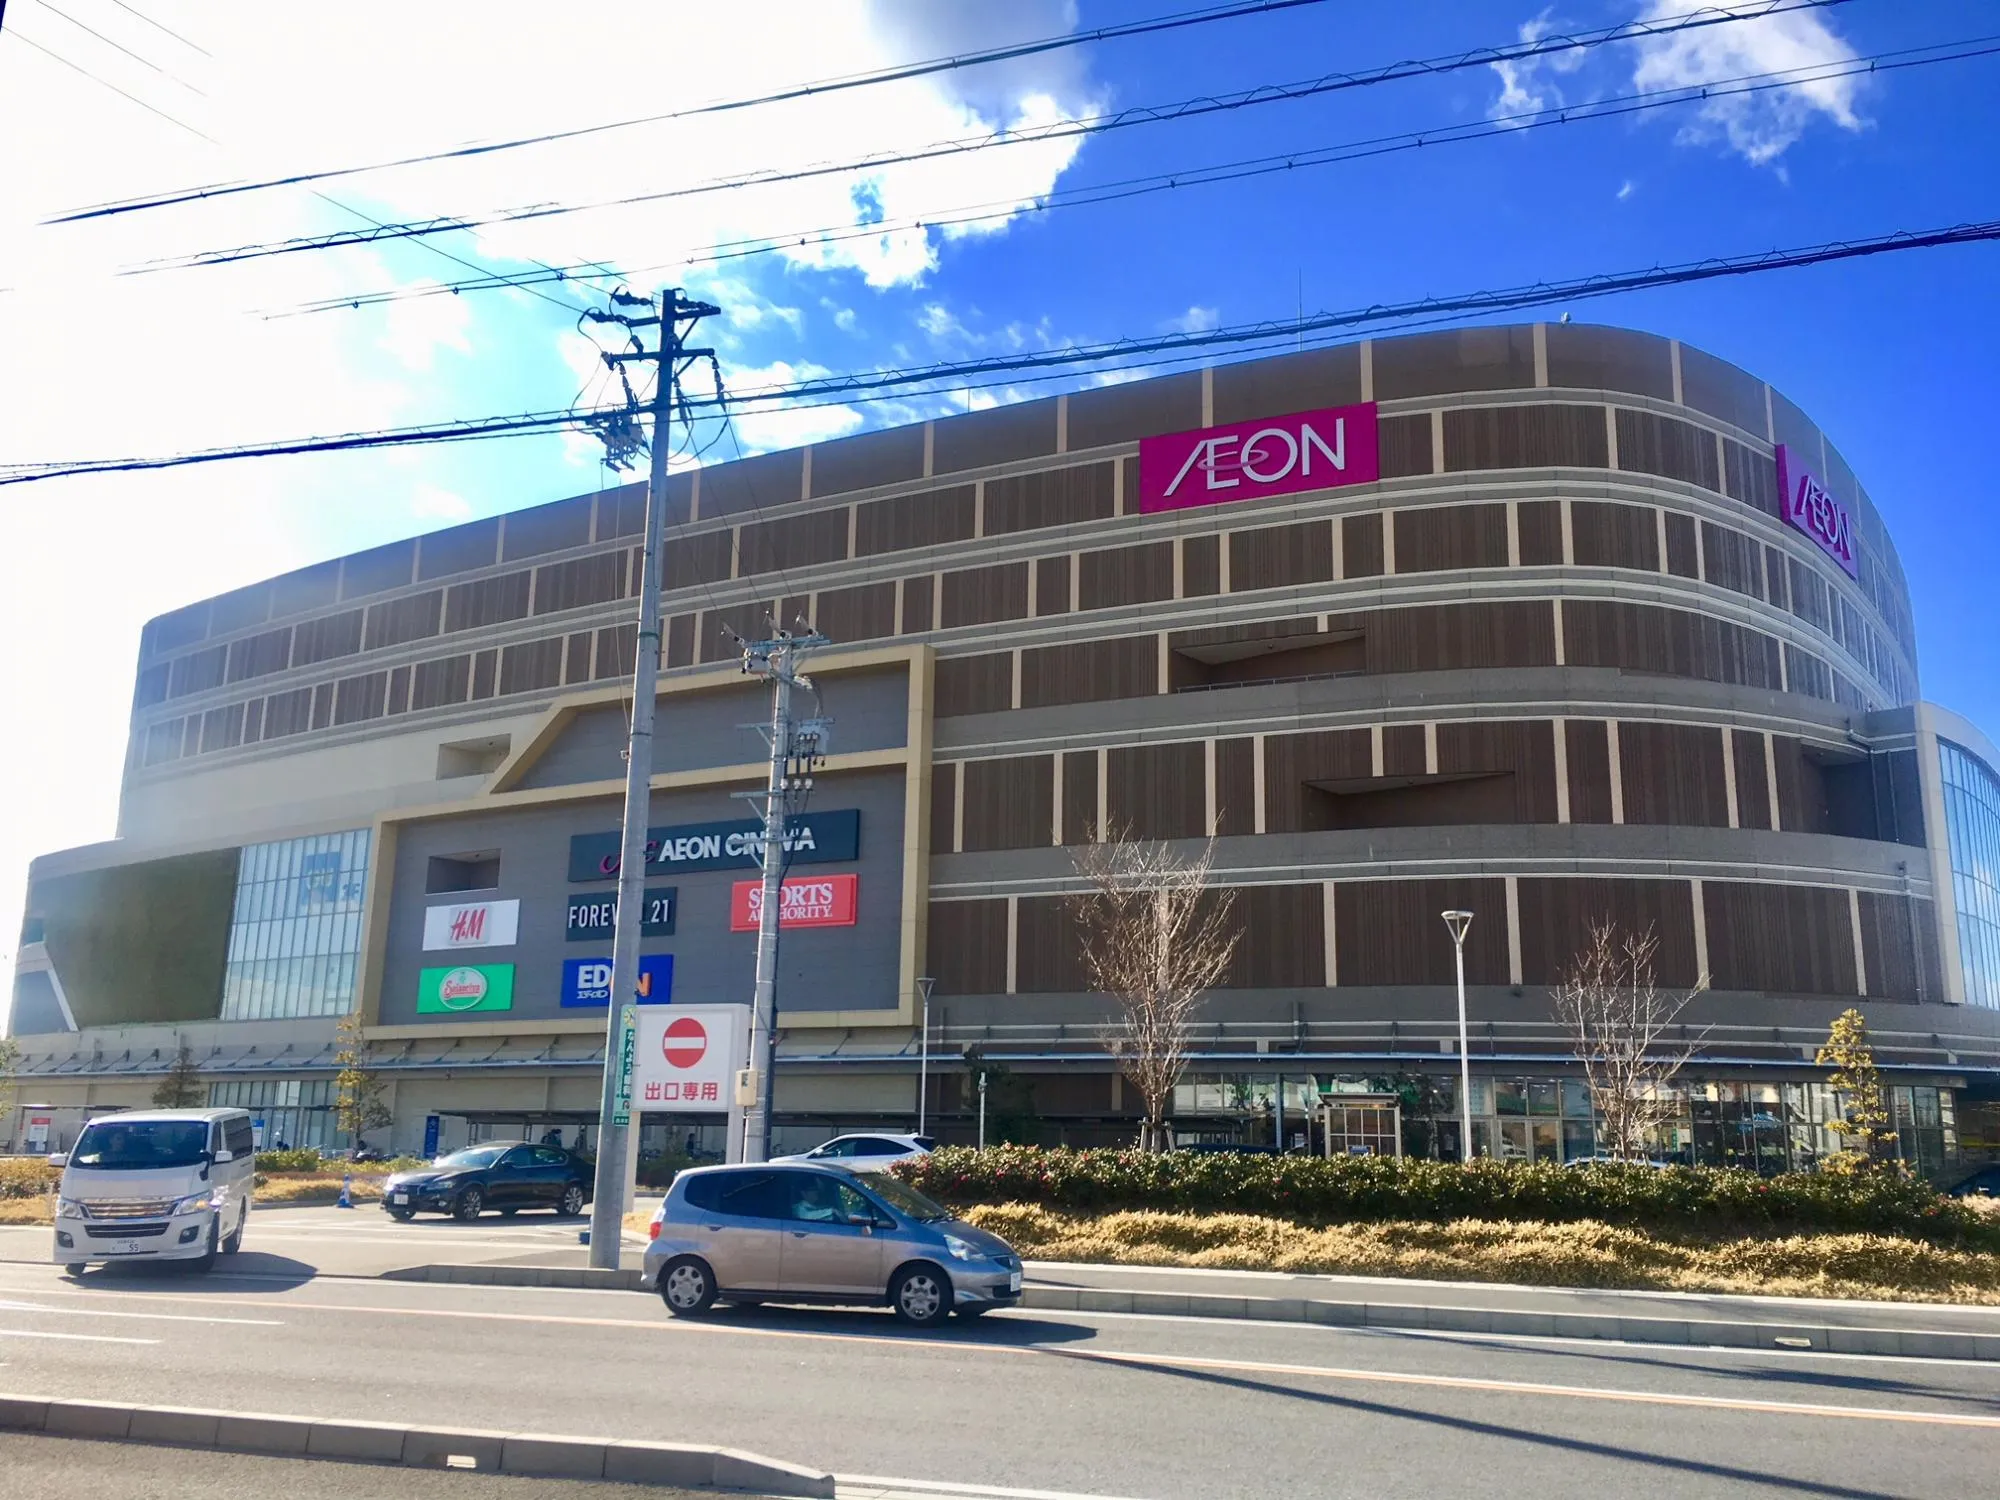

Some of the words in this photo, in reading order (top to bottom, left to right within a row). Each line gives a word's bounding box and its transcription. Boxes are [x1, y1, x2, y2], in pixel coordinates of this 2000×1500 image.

[658, 835, 720, 862] AEON
[725, 827, 816, 856] CINMA
[748, 883, 832, 909] SORTS
[651, 899, 669, 923] 21
[748, 905, 832, 922] AHORITY
[450, 908, 486, 942] H&M
[577, 964, 652, 997] EDN
[645, 1082, 718, 1101] 出口専用
